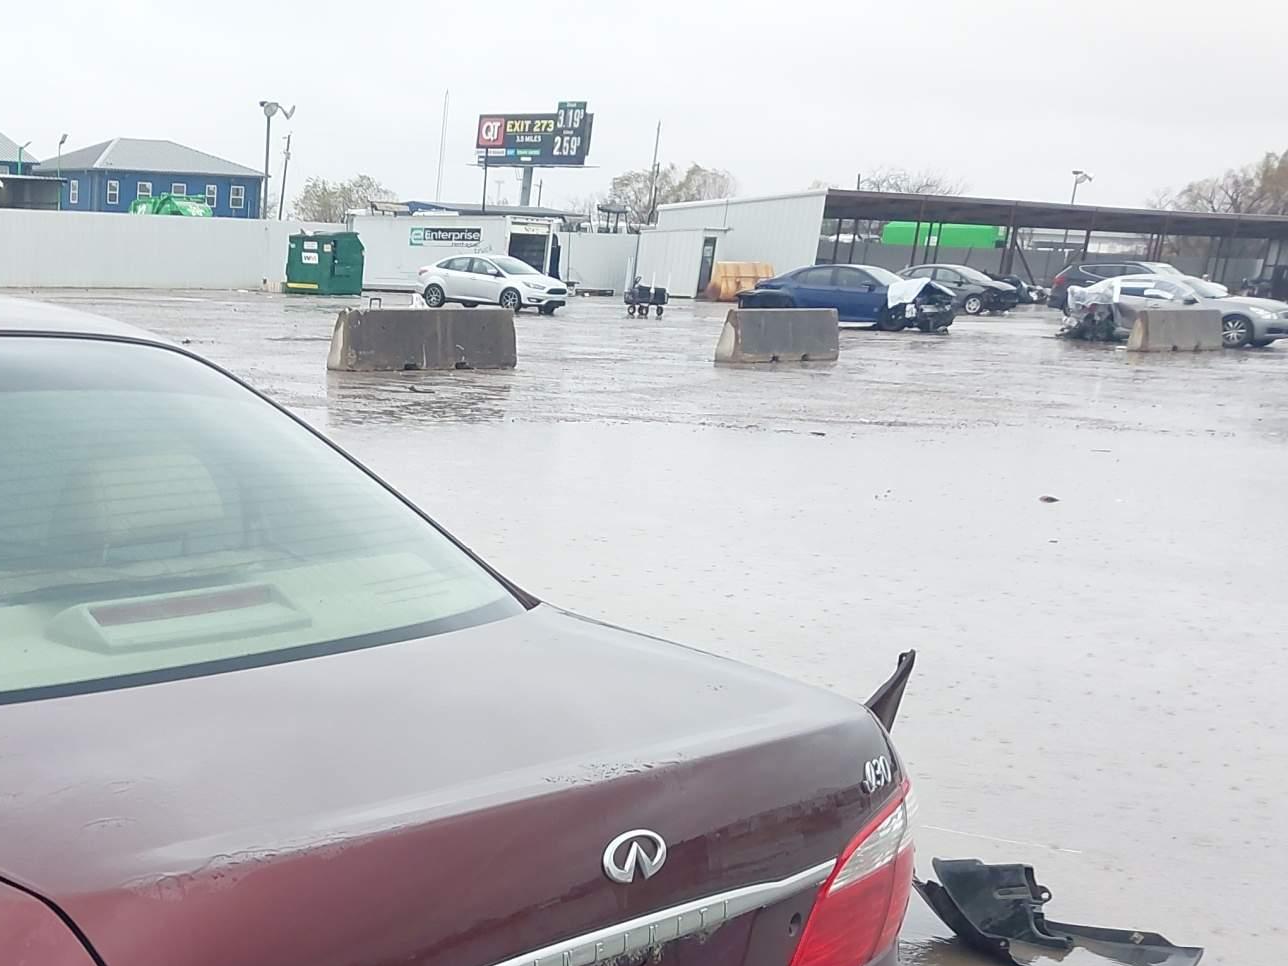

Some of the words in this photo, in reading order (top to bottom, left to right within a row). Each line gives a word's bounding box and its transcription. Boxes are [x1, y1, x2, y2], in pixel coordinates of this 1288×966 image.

[481, 121, 500, 142] QT
[506, 120, 531, 132] EXIT
[532, 119, 554, 132] 273
[424, 229, 480, 242] Enterprise
